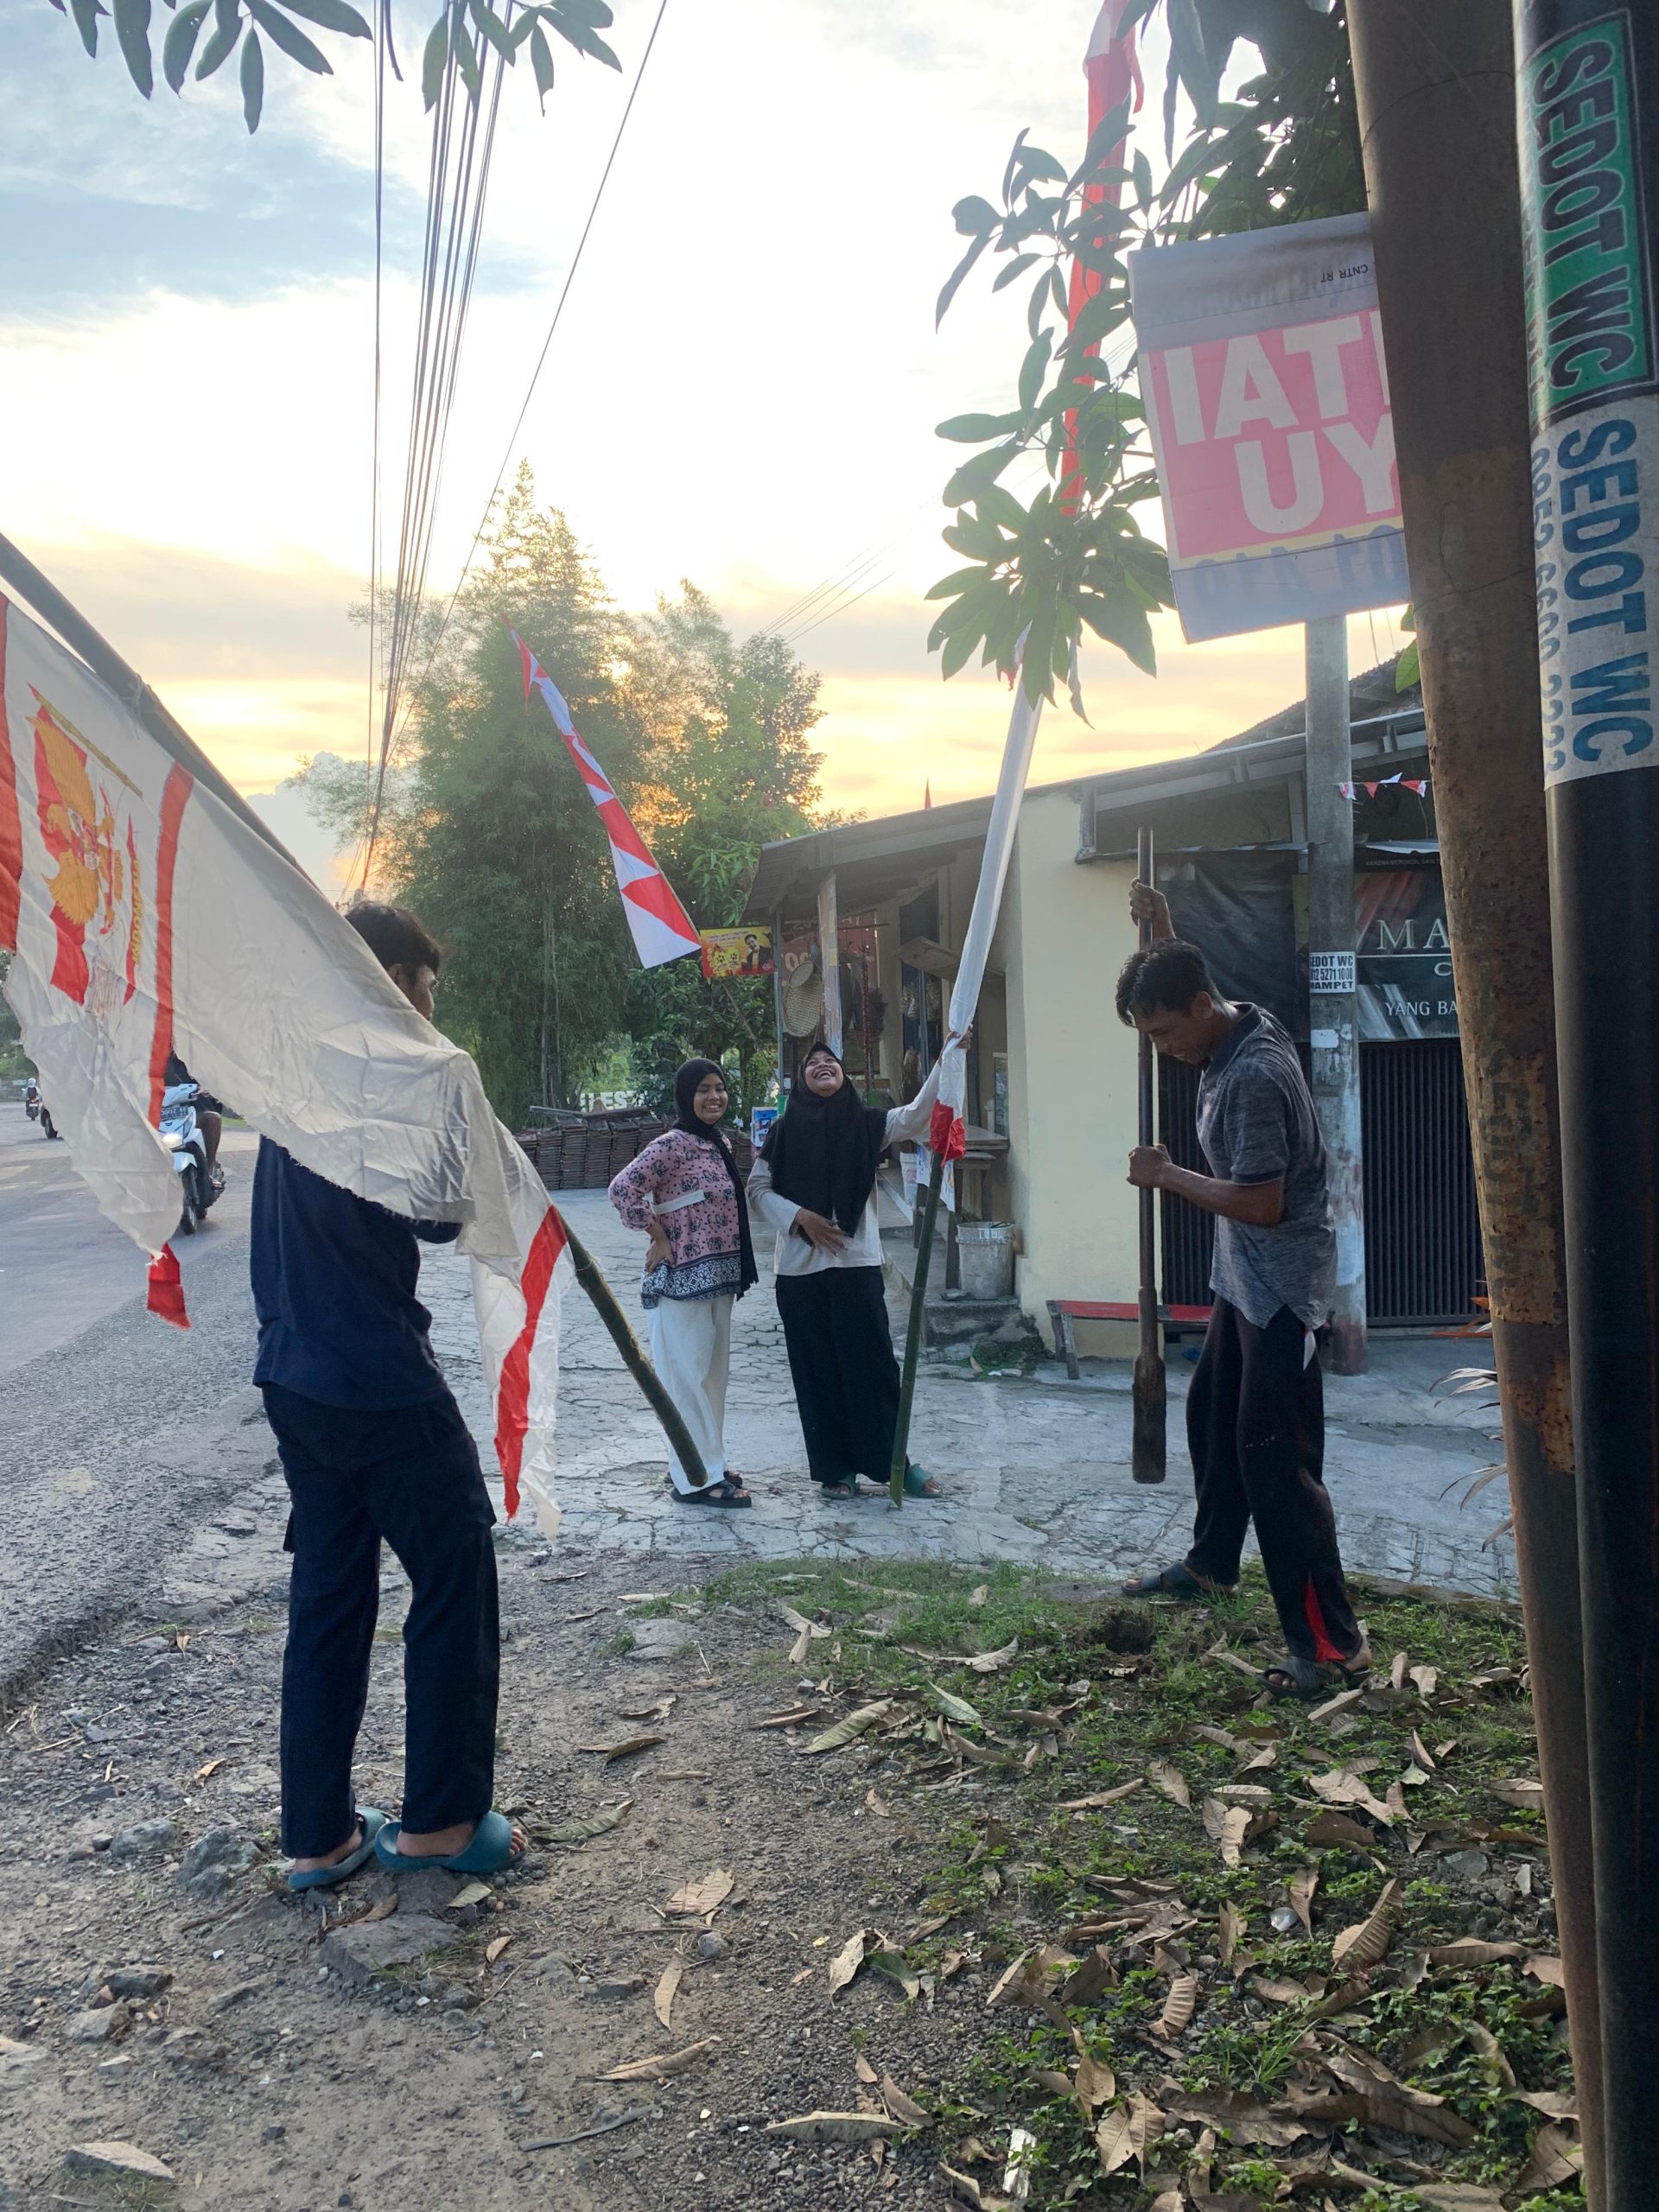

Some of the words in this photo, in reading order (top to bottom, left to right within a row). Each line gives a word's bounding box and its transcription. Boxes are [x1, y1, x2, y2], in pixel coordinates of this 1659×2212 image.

[1534, 40, 1627, 268] SEDOT
[1547, 264, 1636, 389] WC
[1558, 419, 1647, 634] SEDOT
[1571, 652, 1653, 761] WC
[1337, 956, 1353, 966] WC
[1385, 1001, 1430, 1016] YANG
